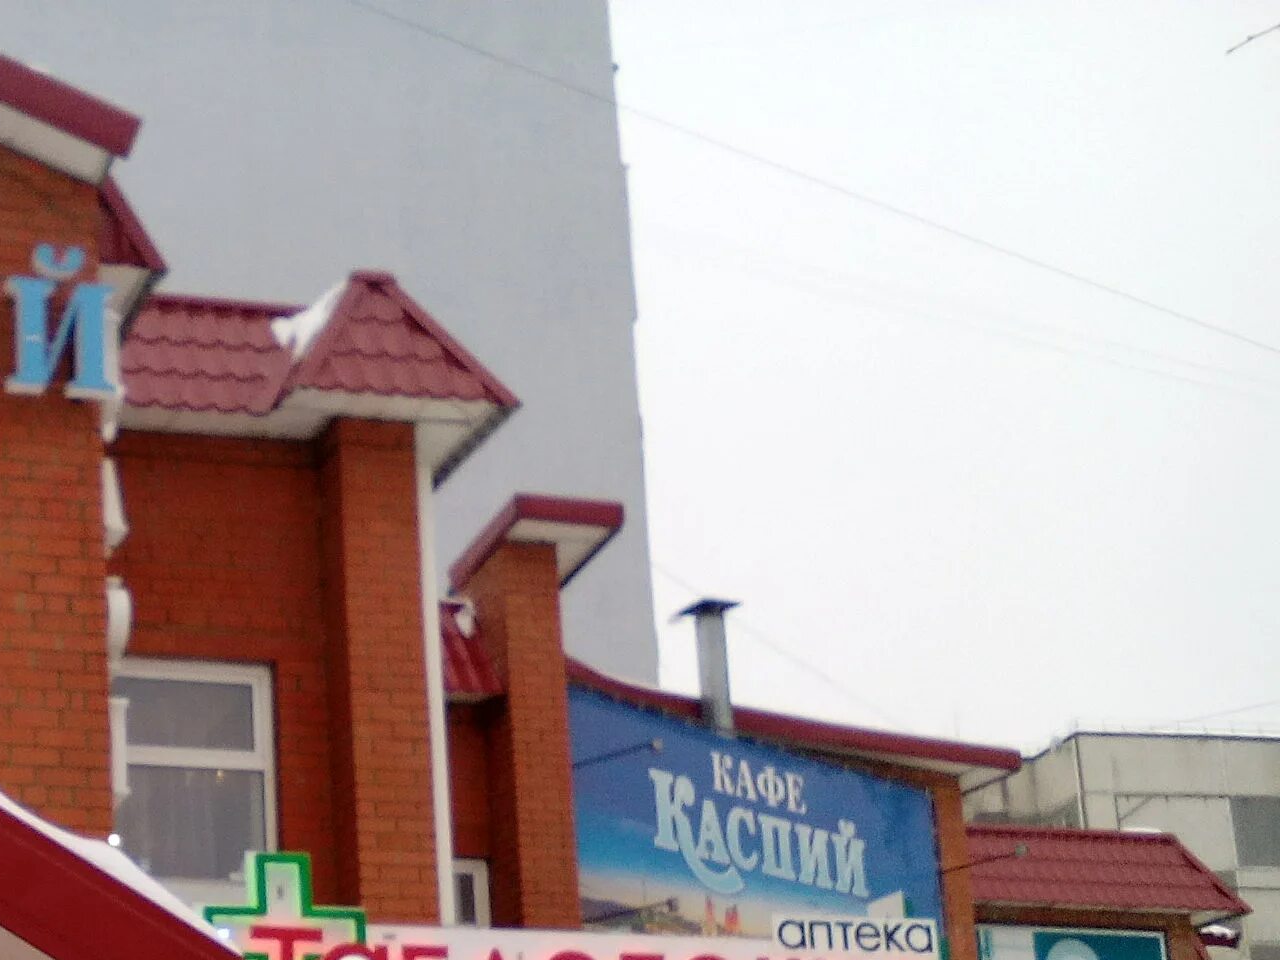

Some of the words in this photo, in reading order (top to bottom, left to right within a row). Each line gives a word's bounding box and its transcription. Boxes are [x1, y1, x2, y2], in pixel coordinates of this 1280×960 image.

[710, 750, 807, 815] КАФЕ
[648, 765, 870, 897] КАСПИЙ
[777, 919, 935, 954] аптека
